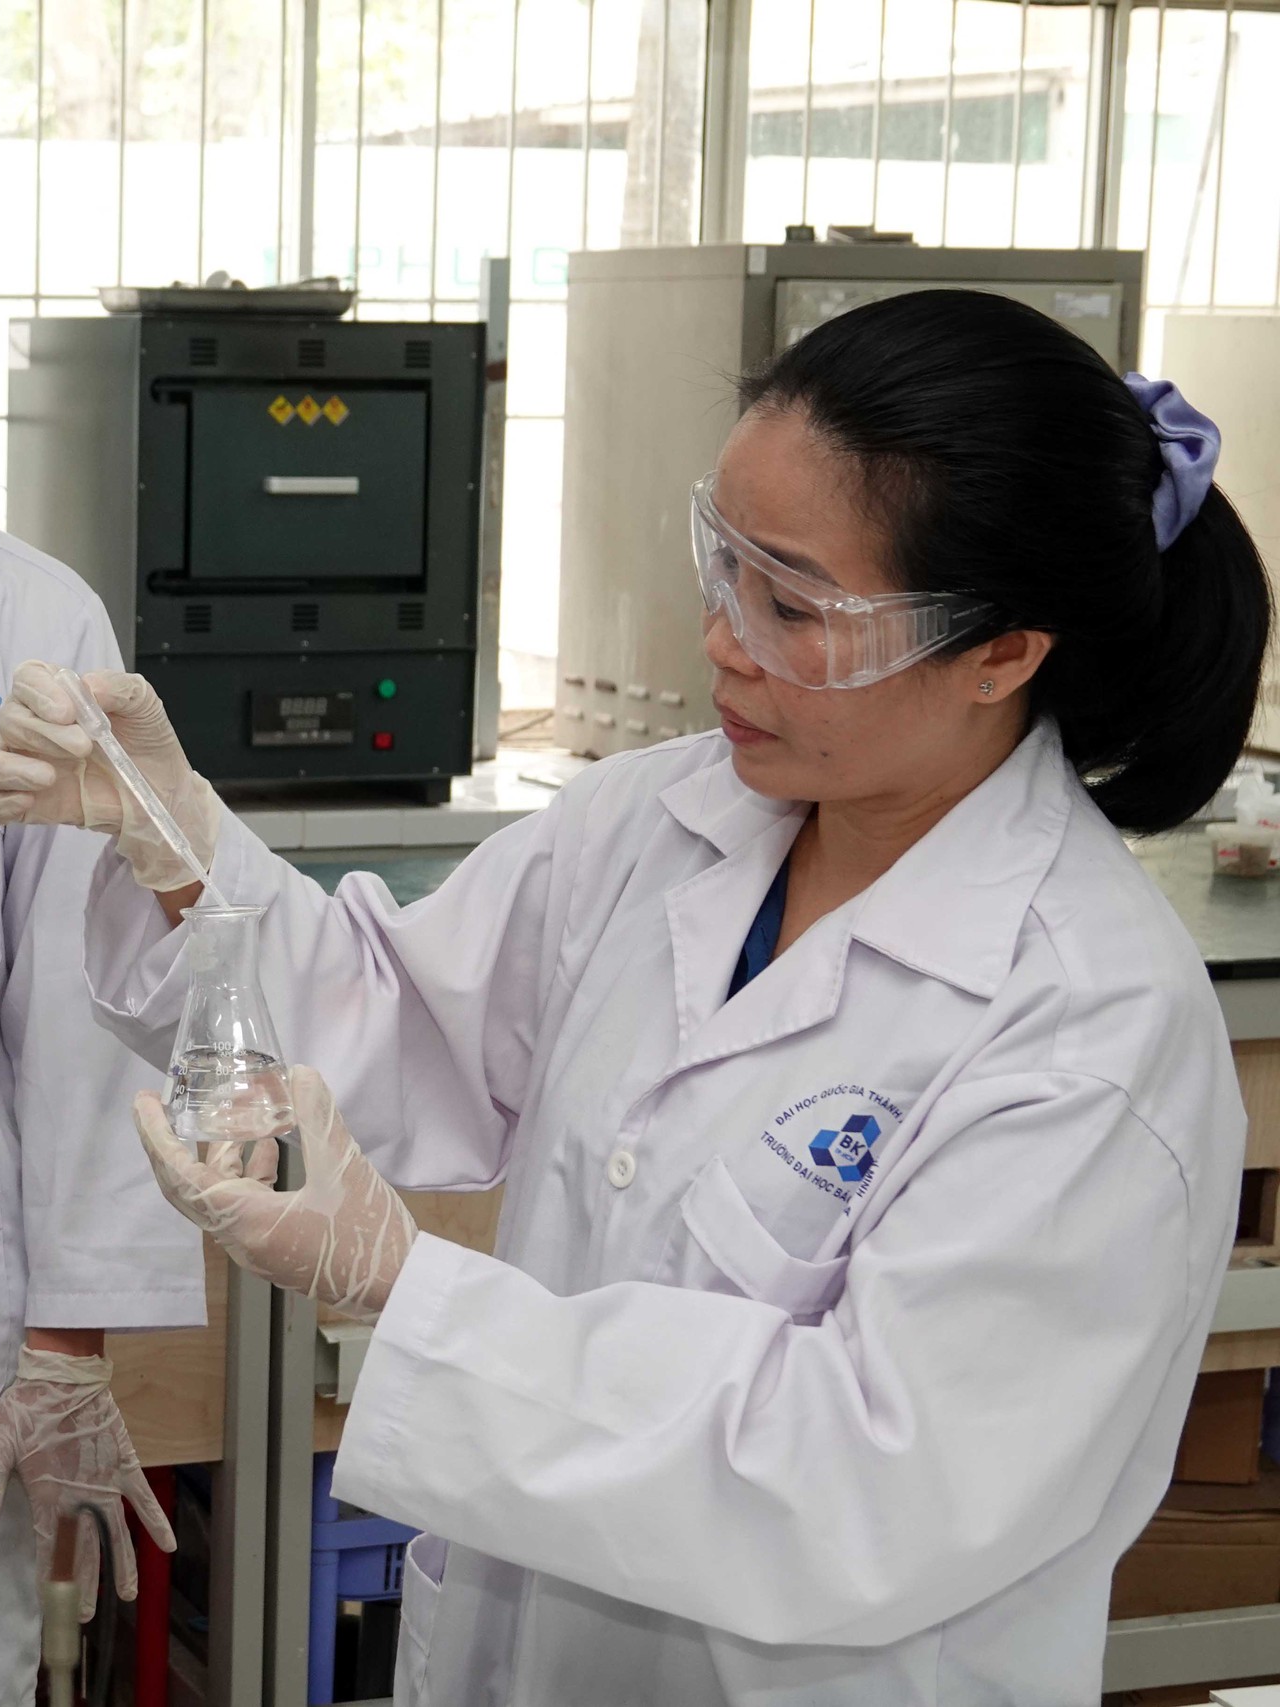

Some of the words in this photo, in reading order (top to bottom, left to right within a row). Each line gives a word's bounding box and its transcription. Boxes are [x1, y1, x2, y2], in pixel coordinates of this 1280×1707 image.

[212, 1041, 231, 1051] 100
[215, 1065, 229, 1076] 80
[775, 1107, 795, 1126] ĐẠI
[794, 1095, 818, 1112] HỌC
[820, 1083, 848, 1099] QUỐC
[848, 1085, 865, 1097] GIA
[868, 1090, 903, 1119] THÀNH
[839, 1134, 866, 1156] BK
[760, 1130, 795, 1165] TRƯỜNG
[793, 1161, 813, 1180] ĐẠI
[811, 1175, 835, 1192] HỌC
